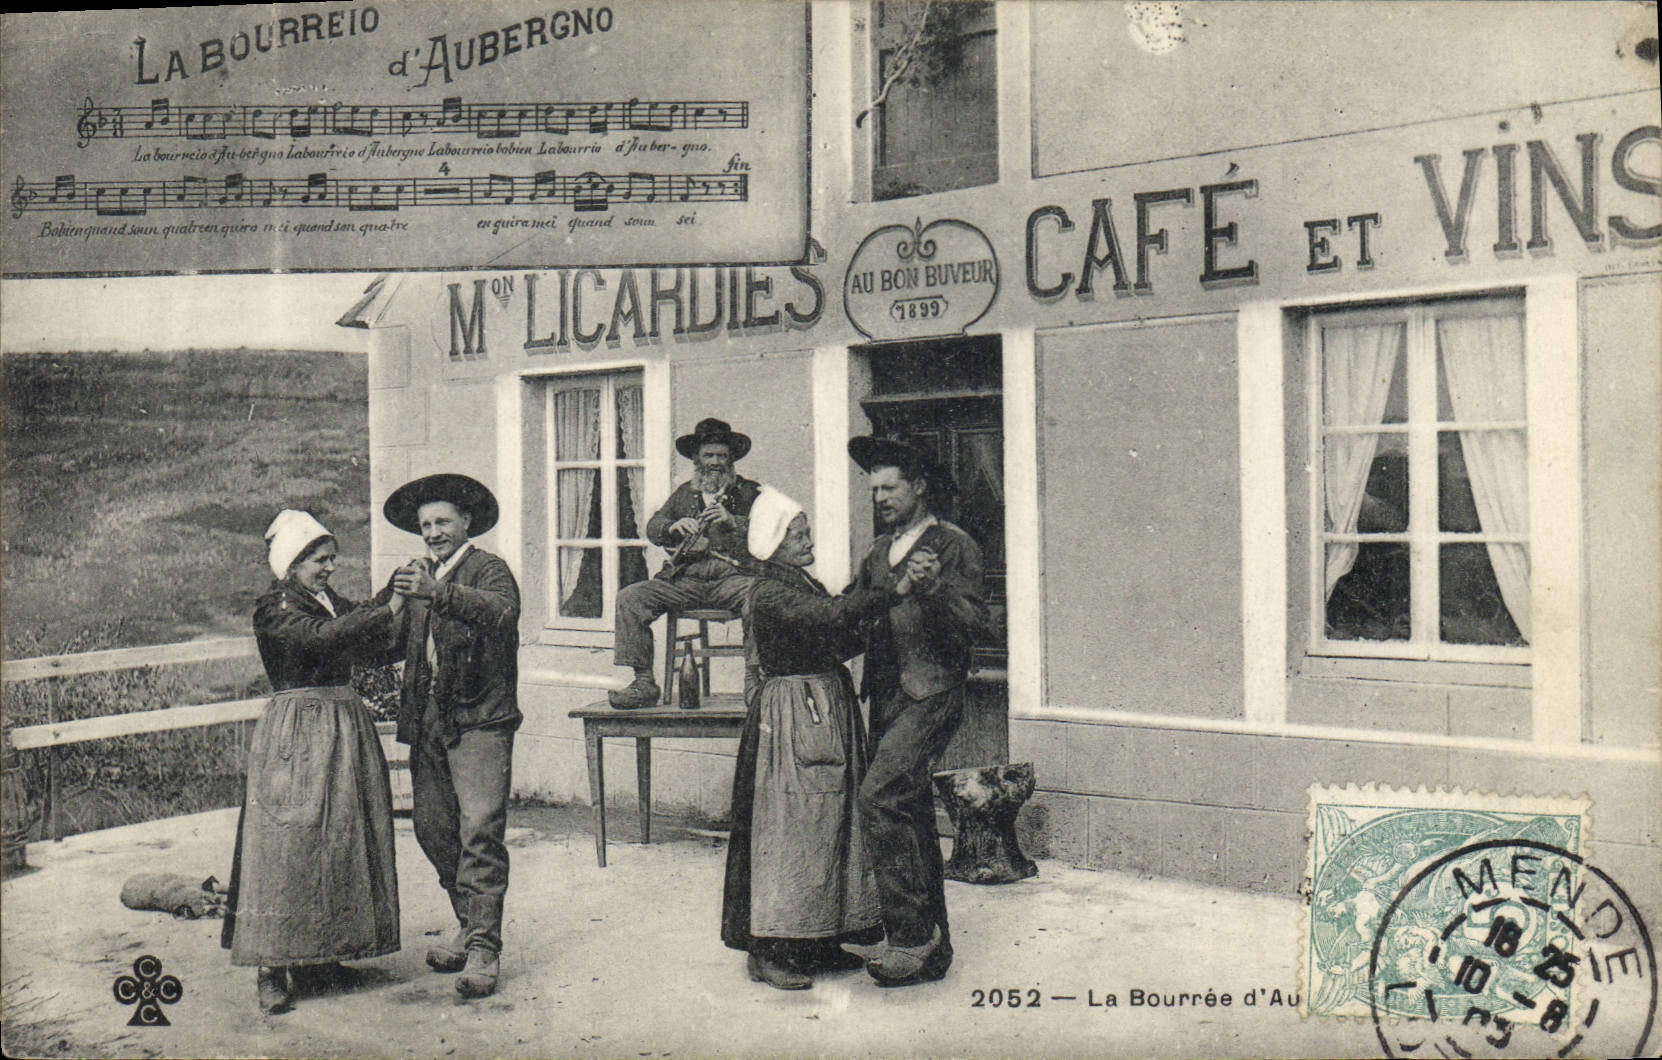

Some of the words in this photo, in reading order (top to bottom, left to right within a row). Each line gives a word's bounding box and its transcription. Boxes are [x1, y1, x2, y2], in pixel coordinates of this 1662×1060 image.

[1025, 162, 1258, 302] CAFÉ
[1303, 212, 1382, 272] ET
[1413, 124, 1661, 265] VINS
[851, 271, 874, 295] AU
[880, 267, 919, 292] BON
[925, 258, 997, 288] BUVEUR
[895, 300, 940, 320] 1899
[1453, 854, 1642, 984] MENDE
[1454, 955, 1491, 995] 10
